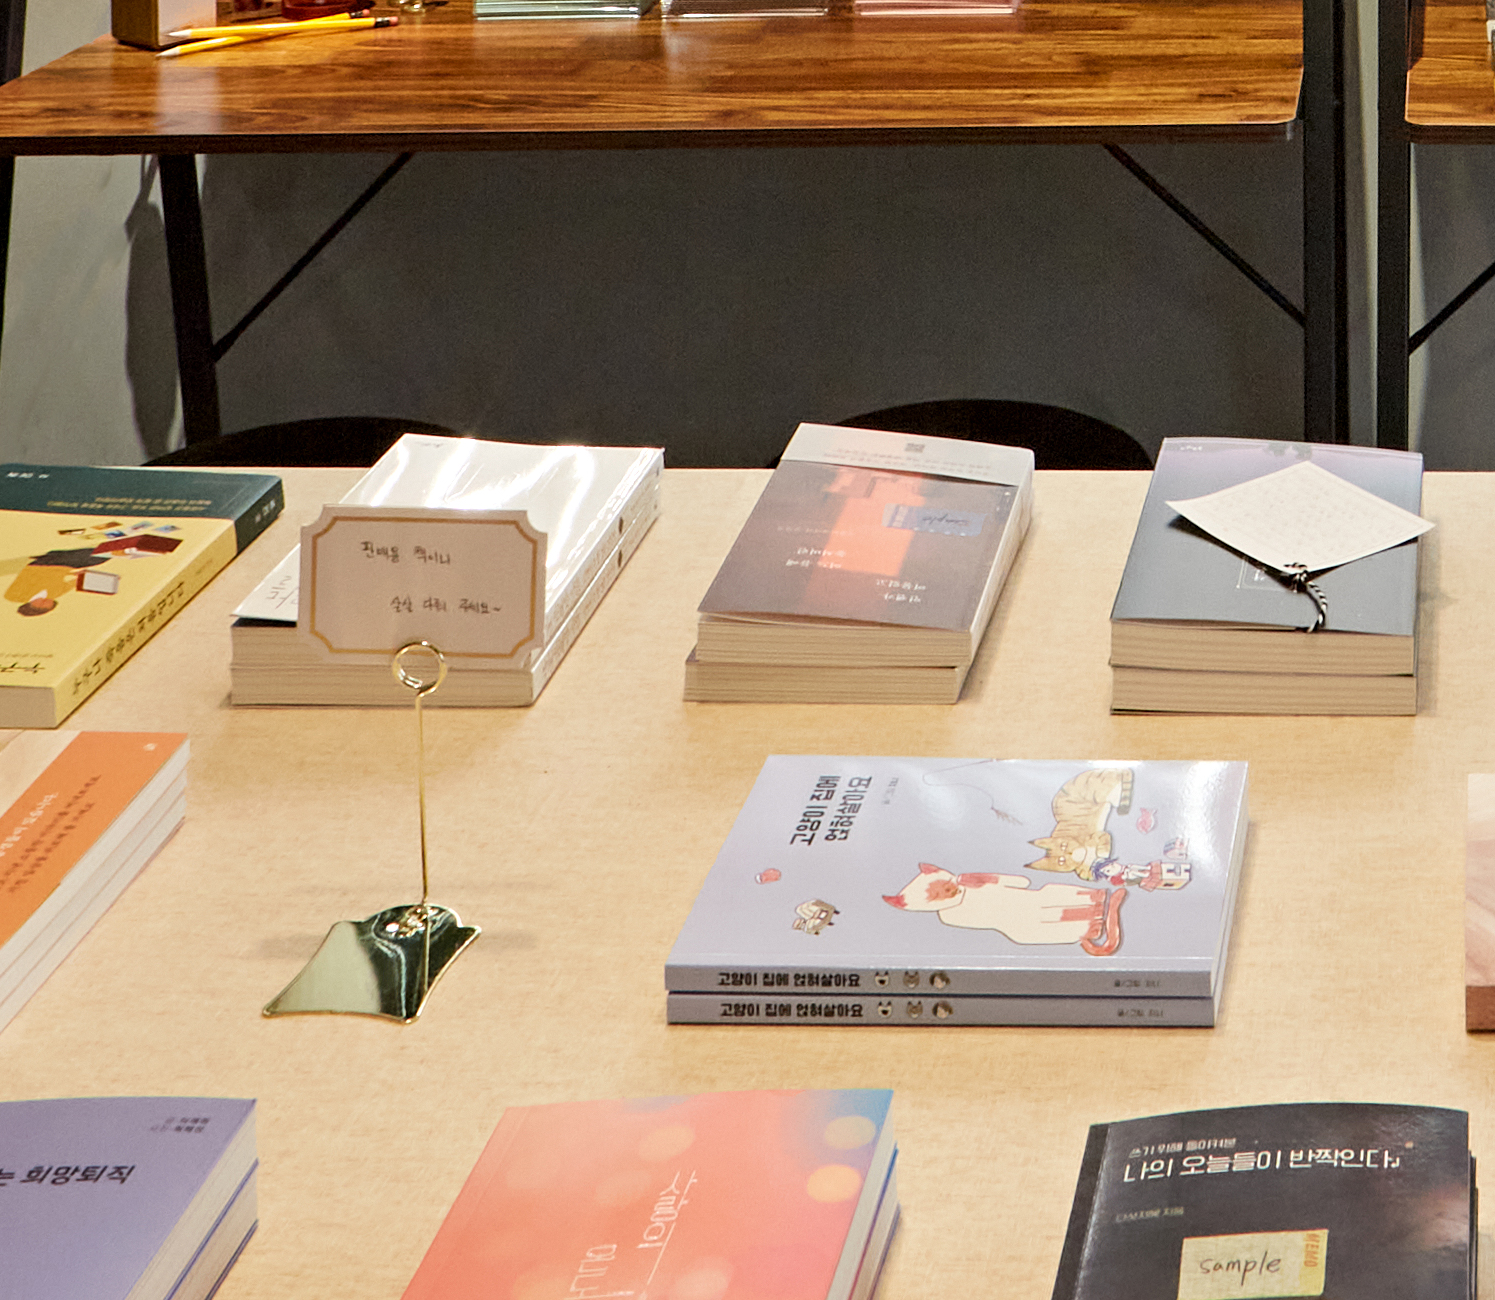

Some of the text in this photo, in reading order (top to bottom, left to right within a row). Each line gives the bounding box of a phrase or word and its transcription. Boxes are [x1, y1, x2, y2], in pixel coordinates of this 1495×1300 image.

[788, 772, 847, 846] 고양이 집에
[823, 777, 873, 842] 얹혀살아요
[717, 972, 861, 987] 고양이 집에 얹혀살아요
[719, 1002, 864, 1018] 고양이 집에 얹혀살아요
[20, 1164, 136, 1186] 희망퇴직
[1122, 1157, 1174, 1183] 나의
[1179, 1150, 1282, 1176] 오늘들이
[1303, 1232, 1321, 1269] MEMO
[1199, 1250, 1283, 1287] sample
